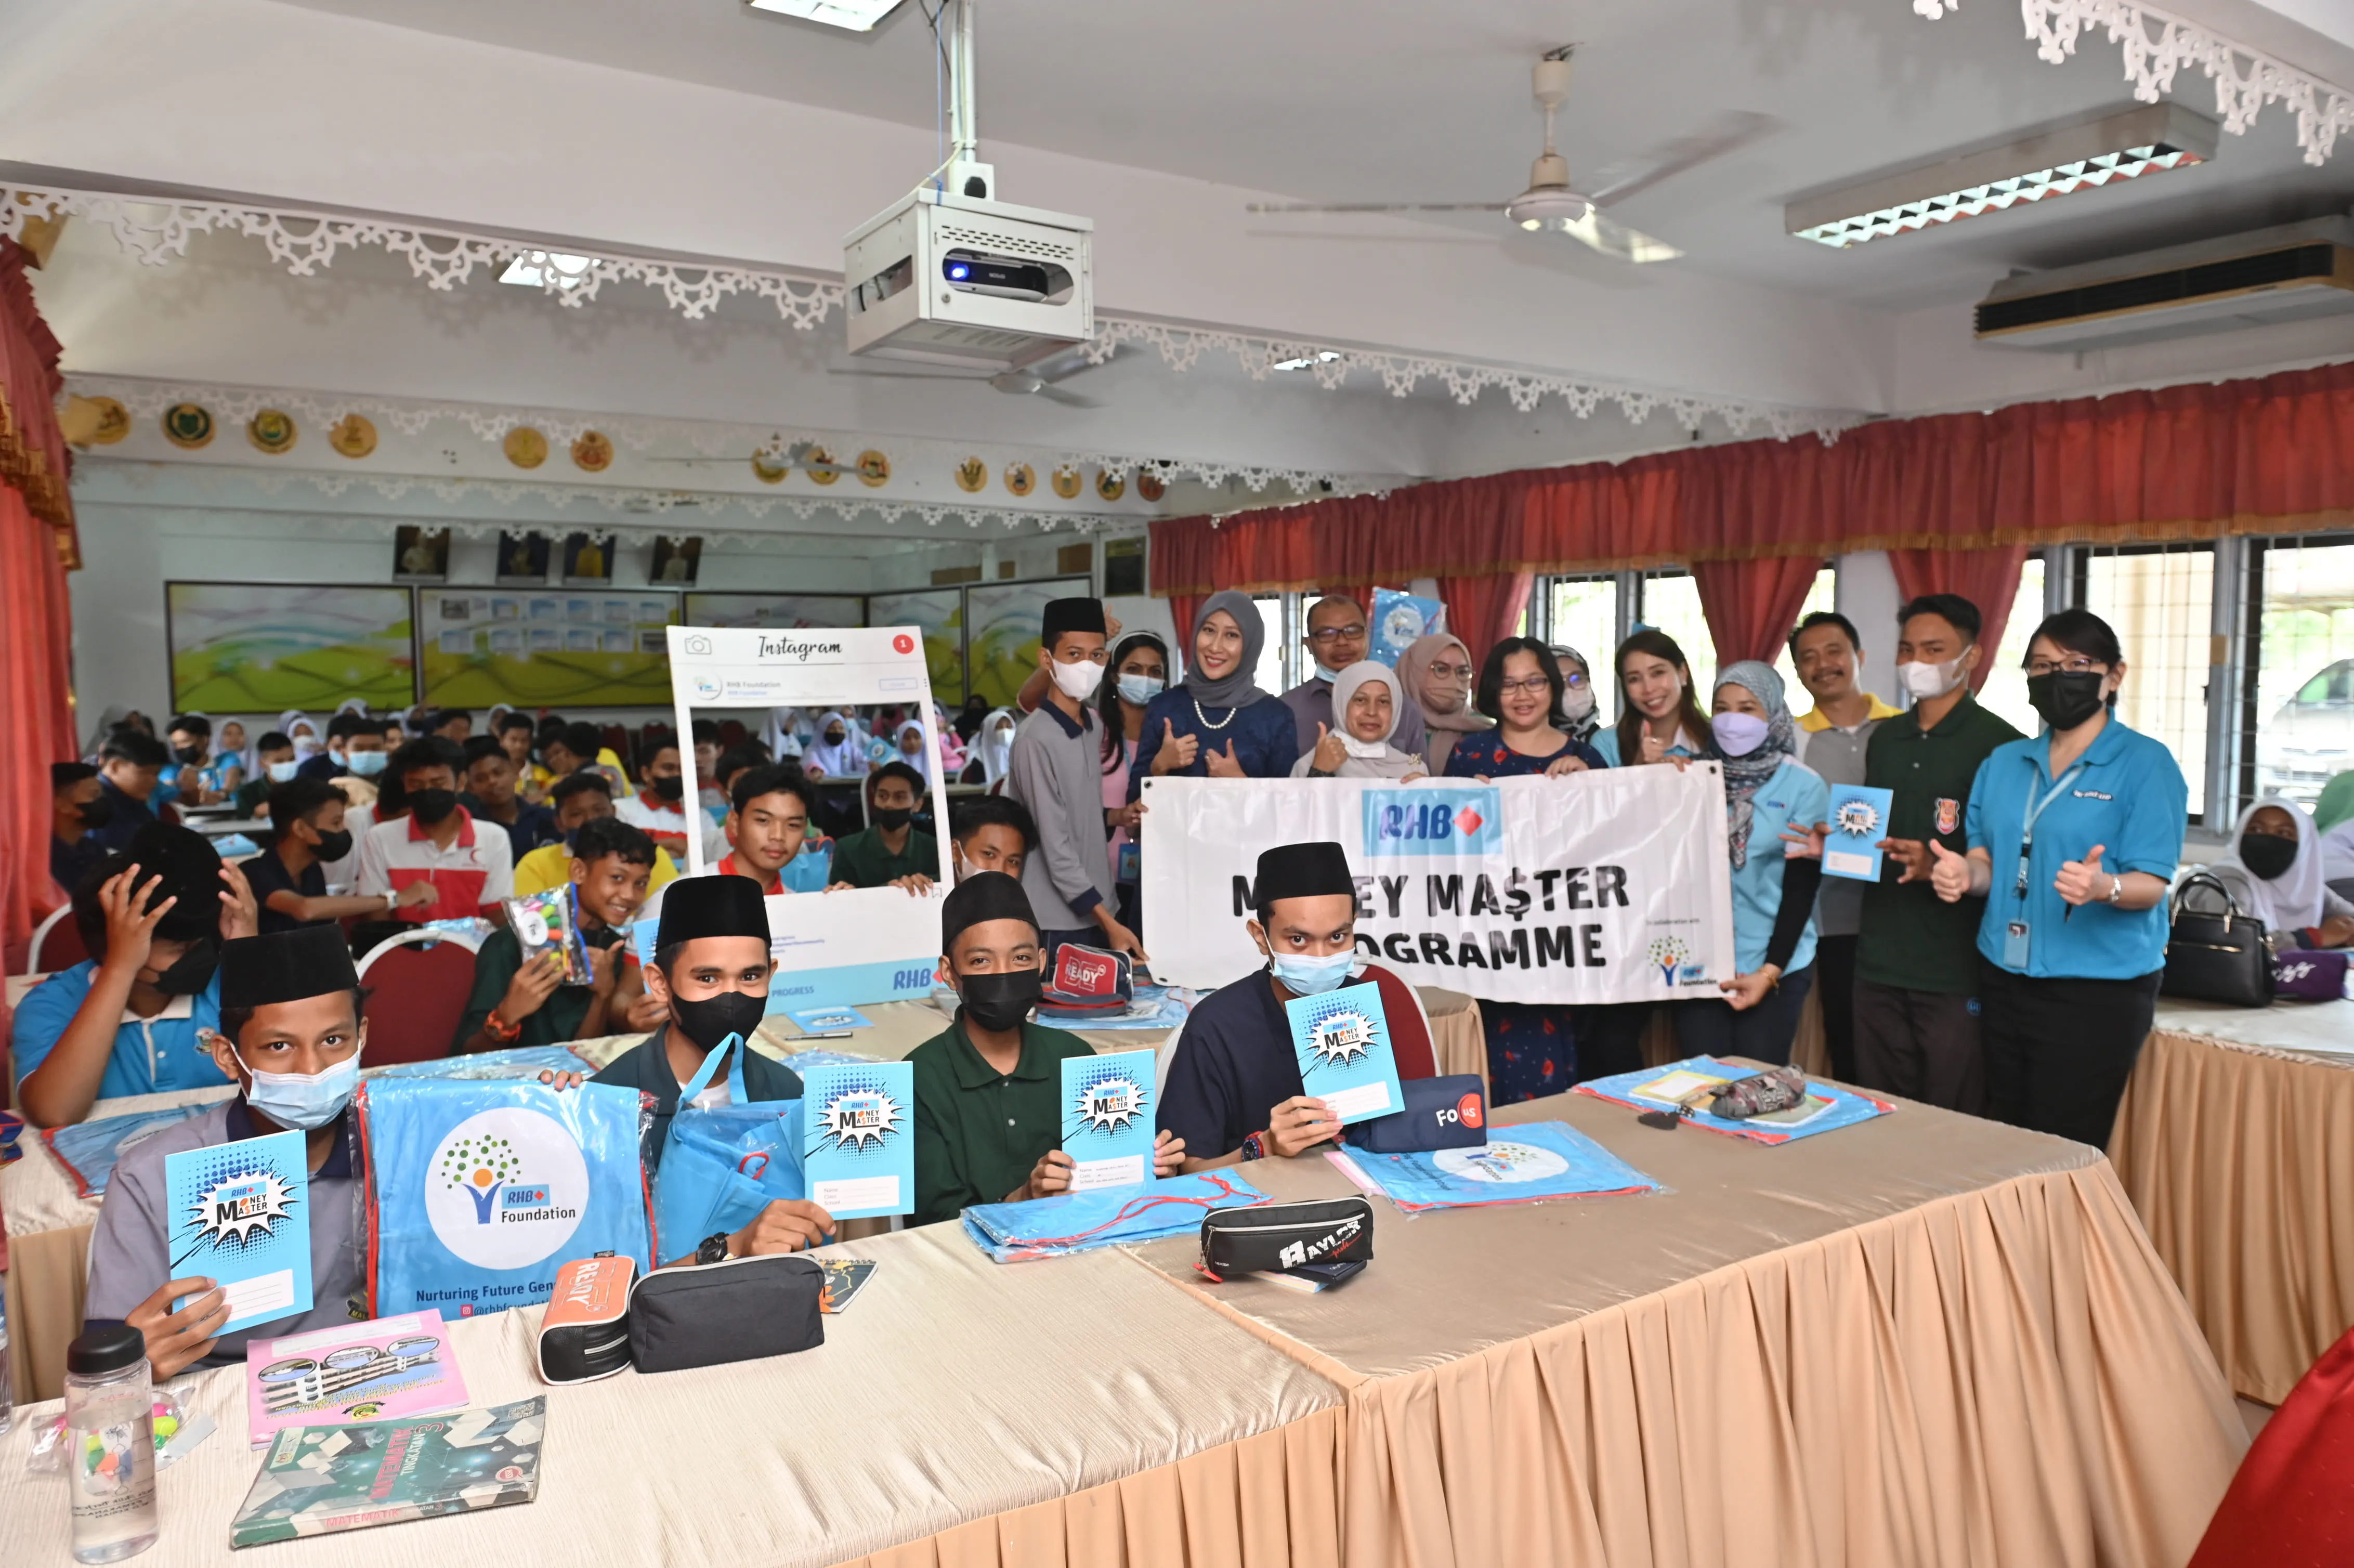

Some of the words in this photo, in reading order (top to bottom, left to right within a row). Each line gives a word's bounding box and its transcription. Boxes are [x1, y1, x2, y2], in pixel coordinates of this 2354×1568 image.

[758, 636, 843, 661] Instagram
[899, 639, 907, 648] 1
[1379, 805, 1451, 840] RHB
[1233, 875, 1408, 918] MEY
[1354, 924, 1606, 971] OGRAMME
[893, 968, 932, 990] RHB
[1065, 963, 1099, 984] READY
[772, 986, 815, 998] PROGRESS
[231, 1187, 247, 1197] RHB
[507, 1190, 533, 1204] RHB
[502, 1207, 576, 1223] Foundation
[416, 1287, 479, 1302] Nurturing
[482, 1285, 525, 1297] Future
[528, 1281, 556, 1293] Gen
[400, 1433, 426, 1476] TINGKATAN
[415, 1422, 444, 1434] 3
[369, 1426, 414, 1499] MATEMATIK
[325, 1508, 400, 1527] MATEMATIK
